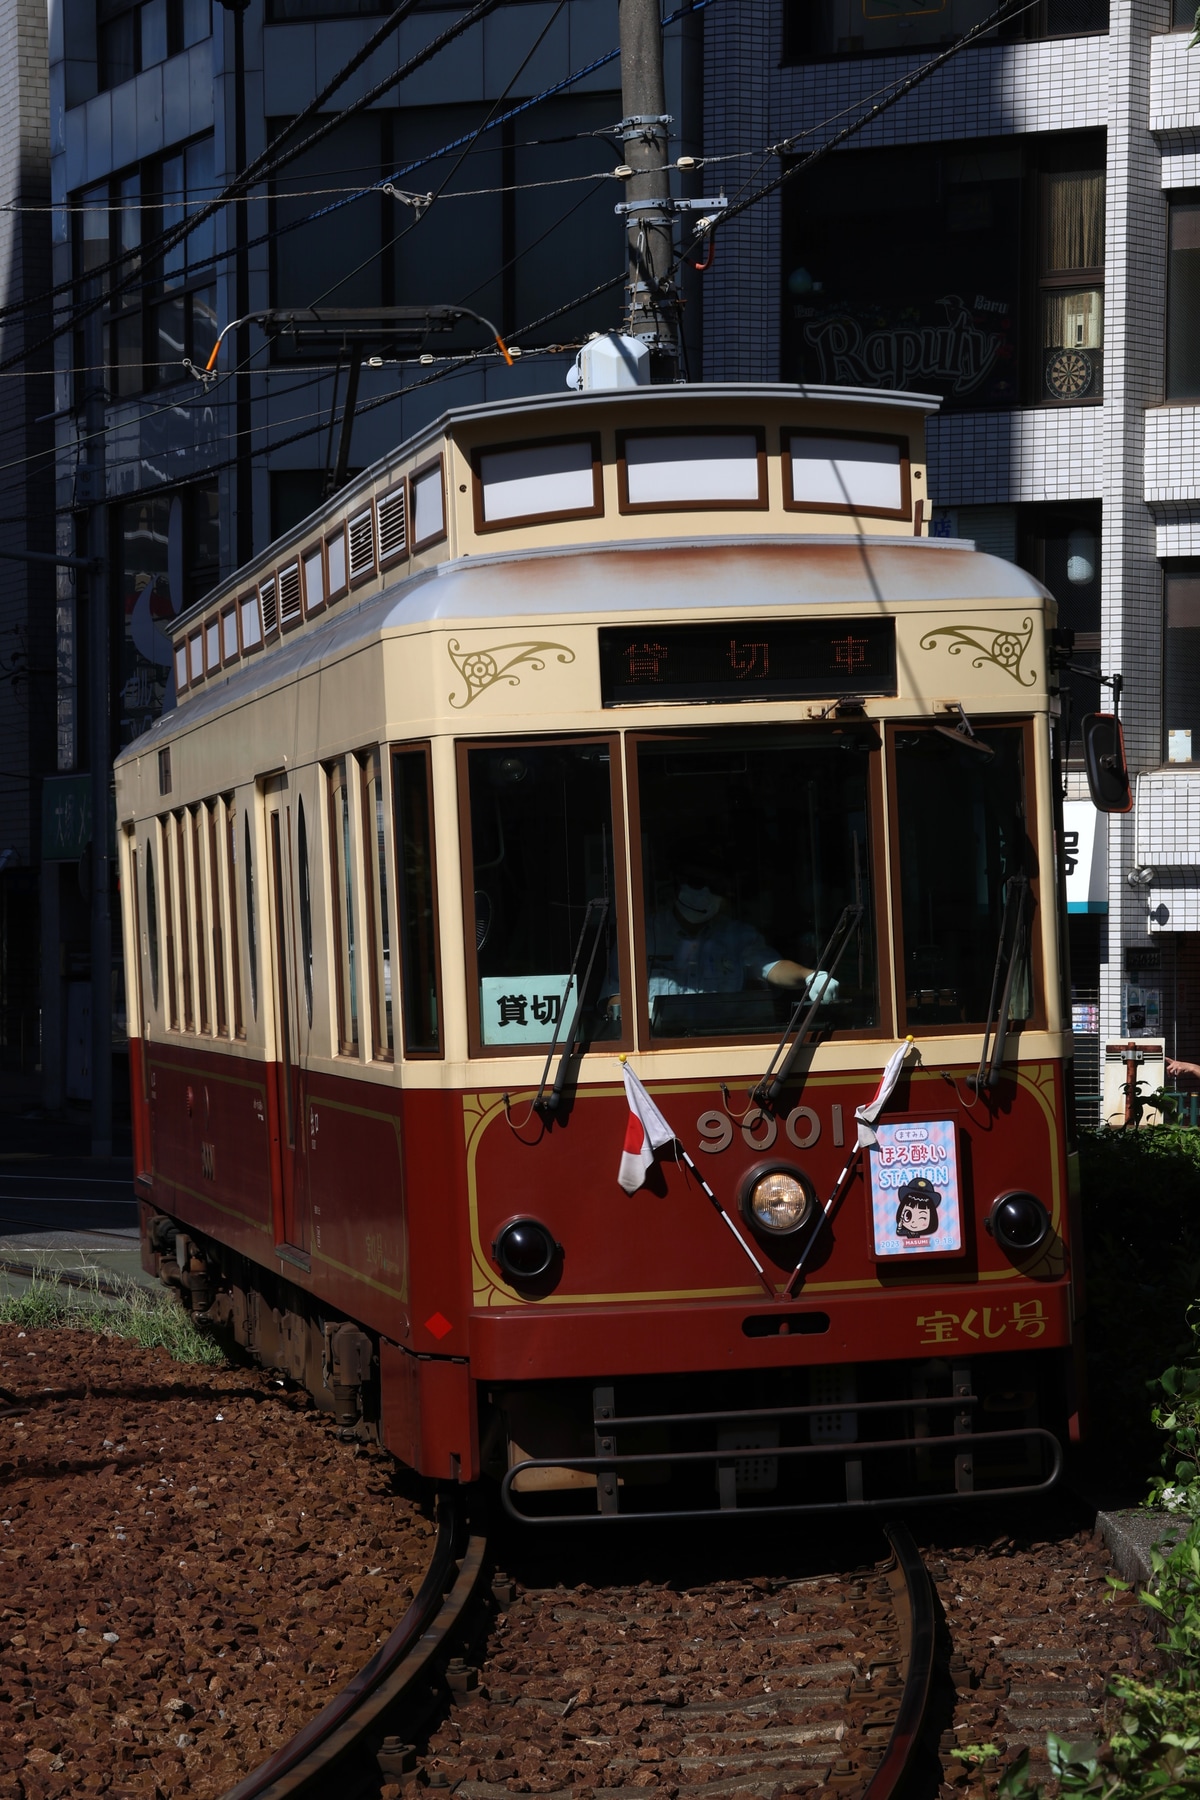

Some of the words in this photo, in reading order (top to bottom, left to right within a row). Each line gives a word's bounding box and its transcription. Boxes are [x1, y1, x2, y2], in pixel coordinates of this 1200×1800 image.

[622, 634, 872, 683] 貸切車
[496, 994, 561, 1027] 貸切
[697, 1103, 844, 1153] 9001
[880, 1144, 946, 1164] ほろ酔い
[879, 1167, 948, 1187] STATION
[916, 1299, 1049, 1345] 宝くじ号
